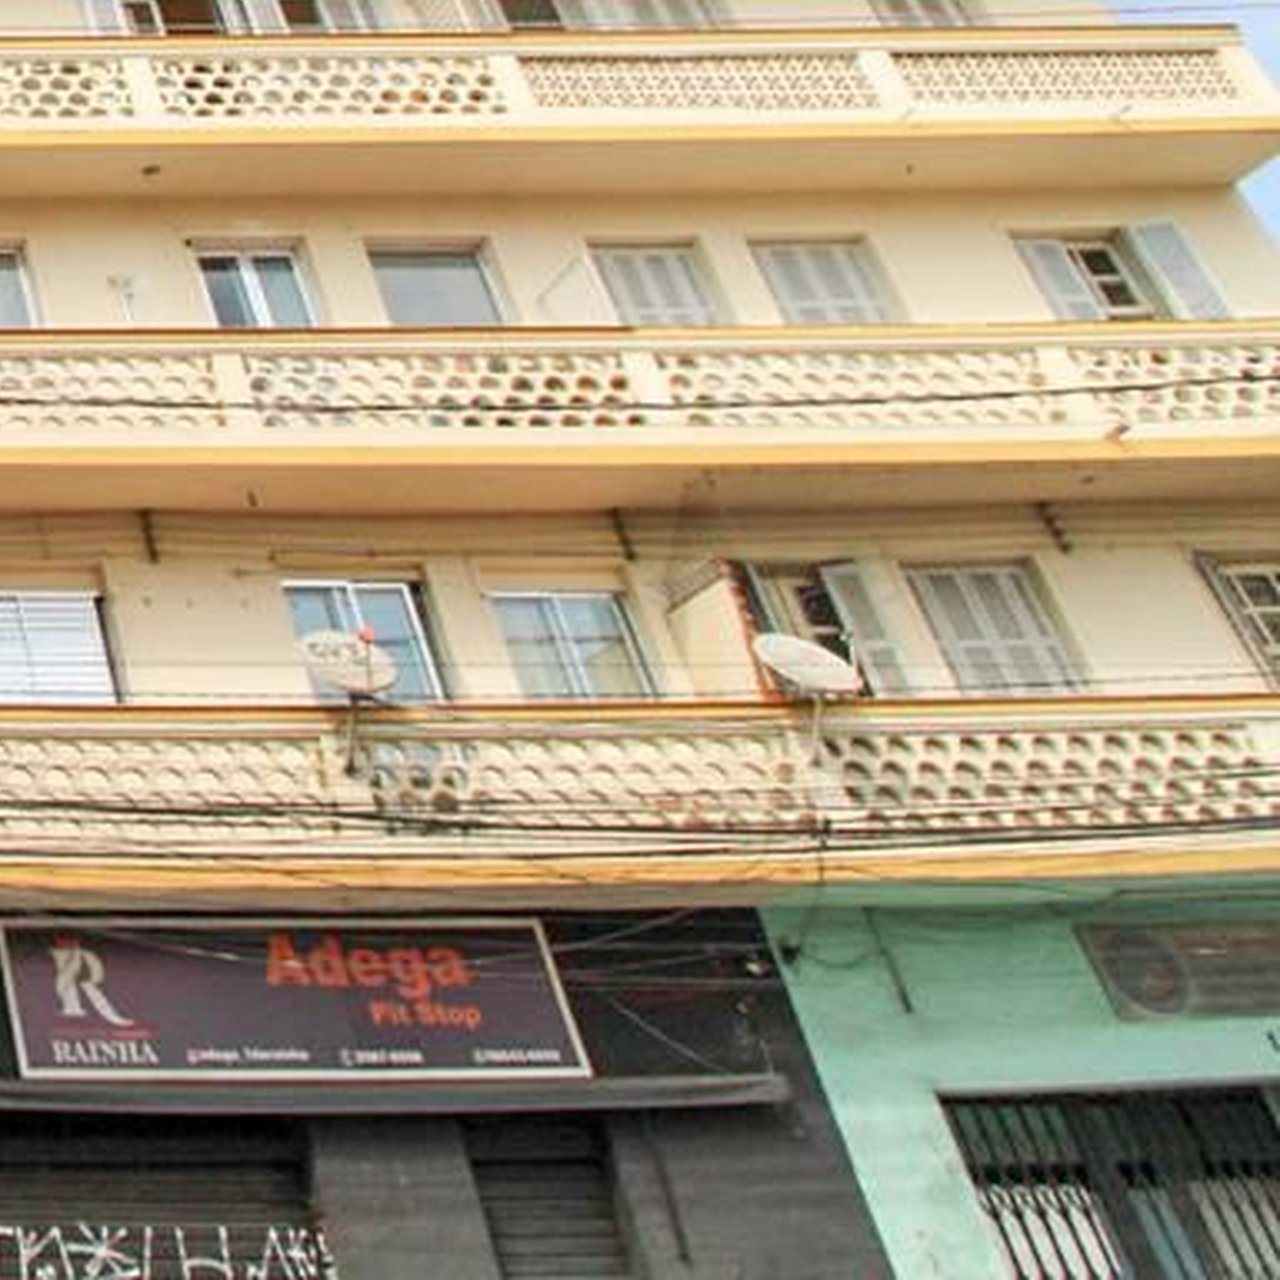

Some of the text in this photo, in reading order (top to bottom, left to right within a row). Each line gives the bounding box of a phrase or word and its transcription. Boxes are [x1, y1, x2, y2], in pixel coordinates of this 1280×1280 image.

[266, 933, 478, 1002] Adega
[413, 1001, 481, 1031] Stop
[51, 1039, 160, 1065] RAINHA
